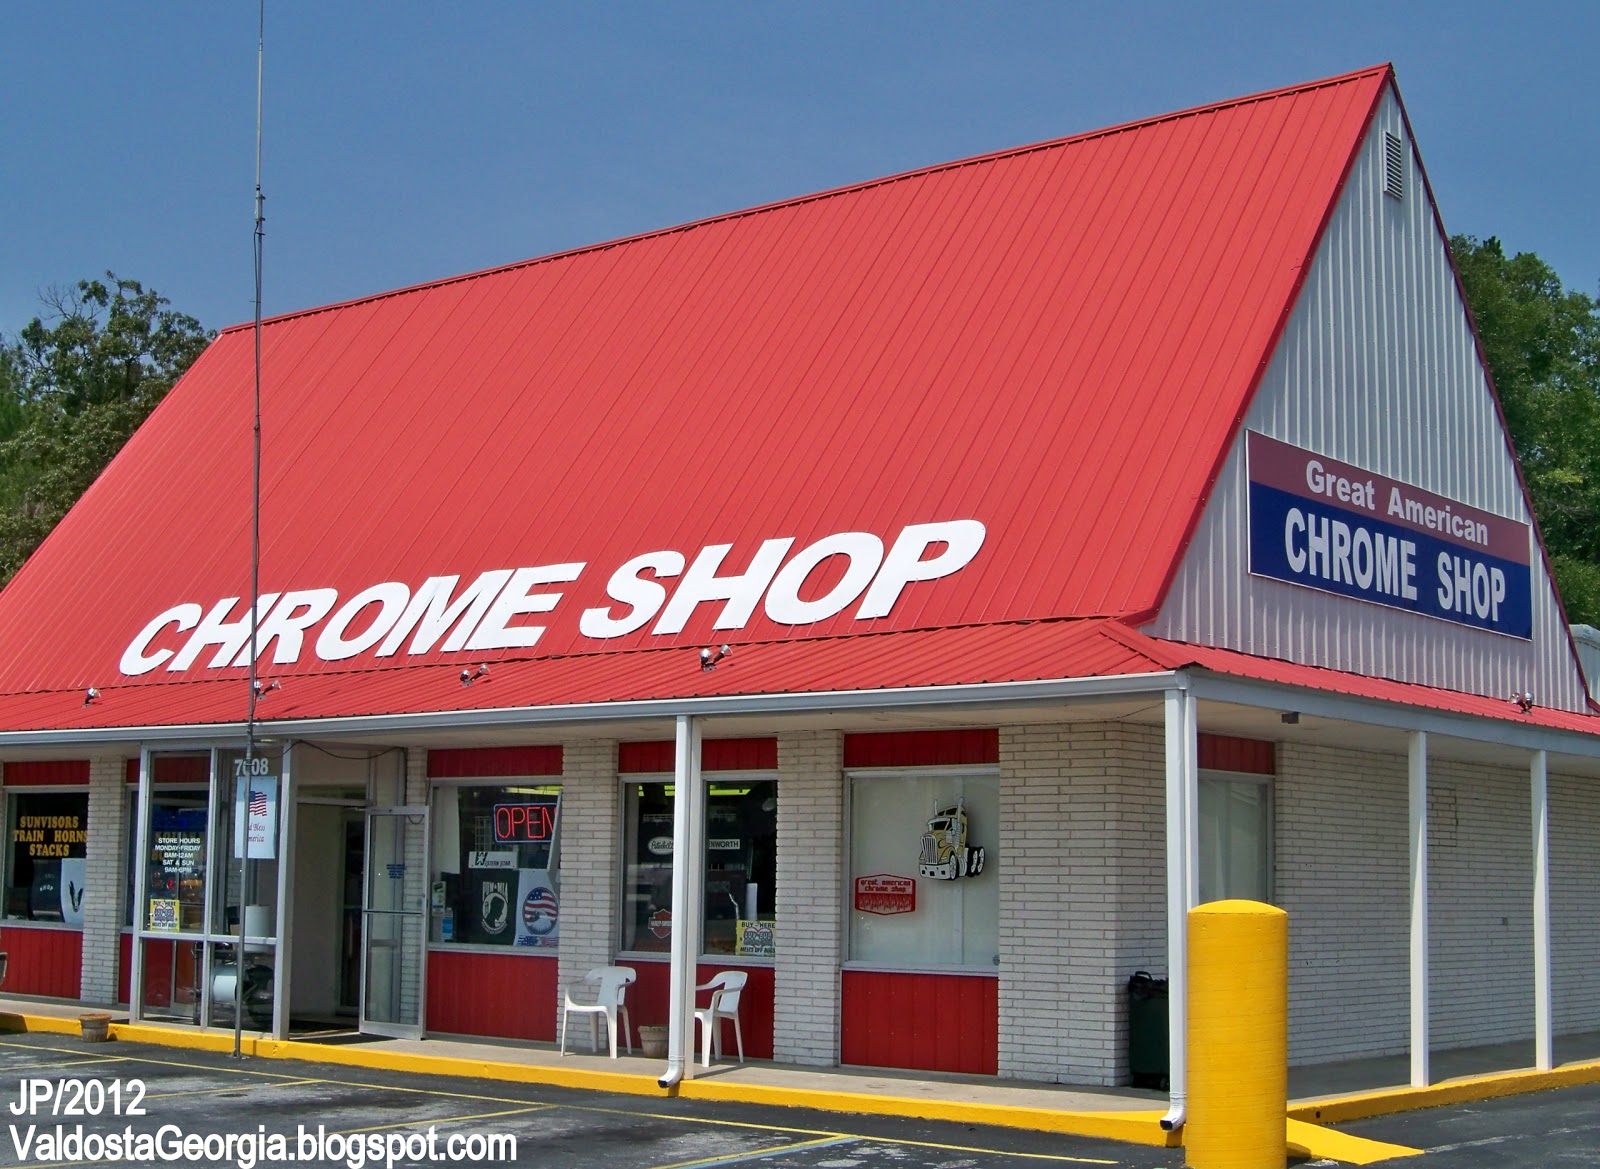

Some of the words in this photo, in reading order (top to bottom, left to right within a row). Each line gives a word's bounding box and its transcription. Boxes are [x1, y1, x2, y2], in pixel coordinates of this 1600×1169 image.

[1306, 459, 1375, 510] Great
[1387, 486, 1488, 546] American
[1284, 507, 1418, 601] CHROME
[1437, 551, 1506, 622] SHOP
[119, 563, 587, 676] CHROME
[580, 519, 986, 638] SHOP
[20, 816, 79, 829] SUNVISORS
[496, 806, 558, 839] OPEN
[13, 830, 45, 842] TRAIN
[248, 834, 265, 842] merica
[29, 844, 70, 857] STACKS
